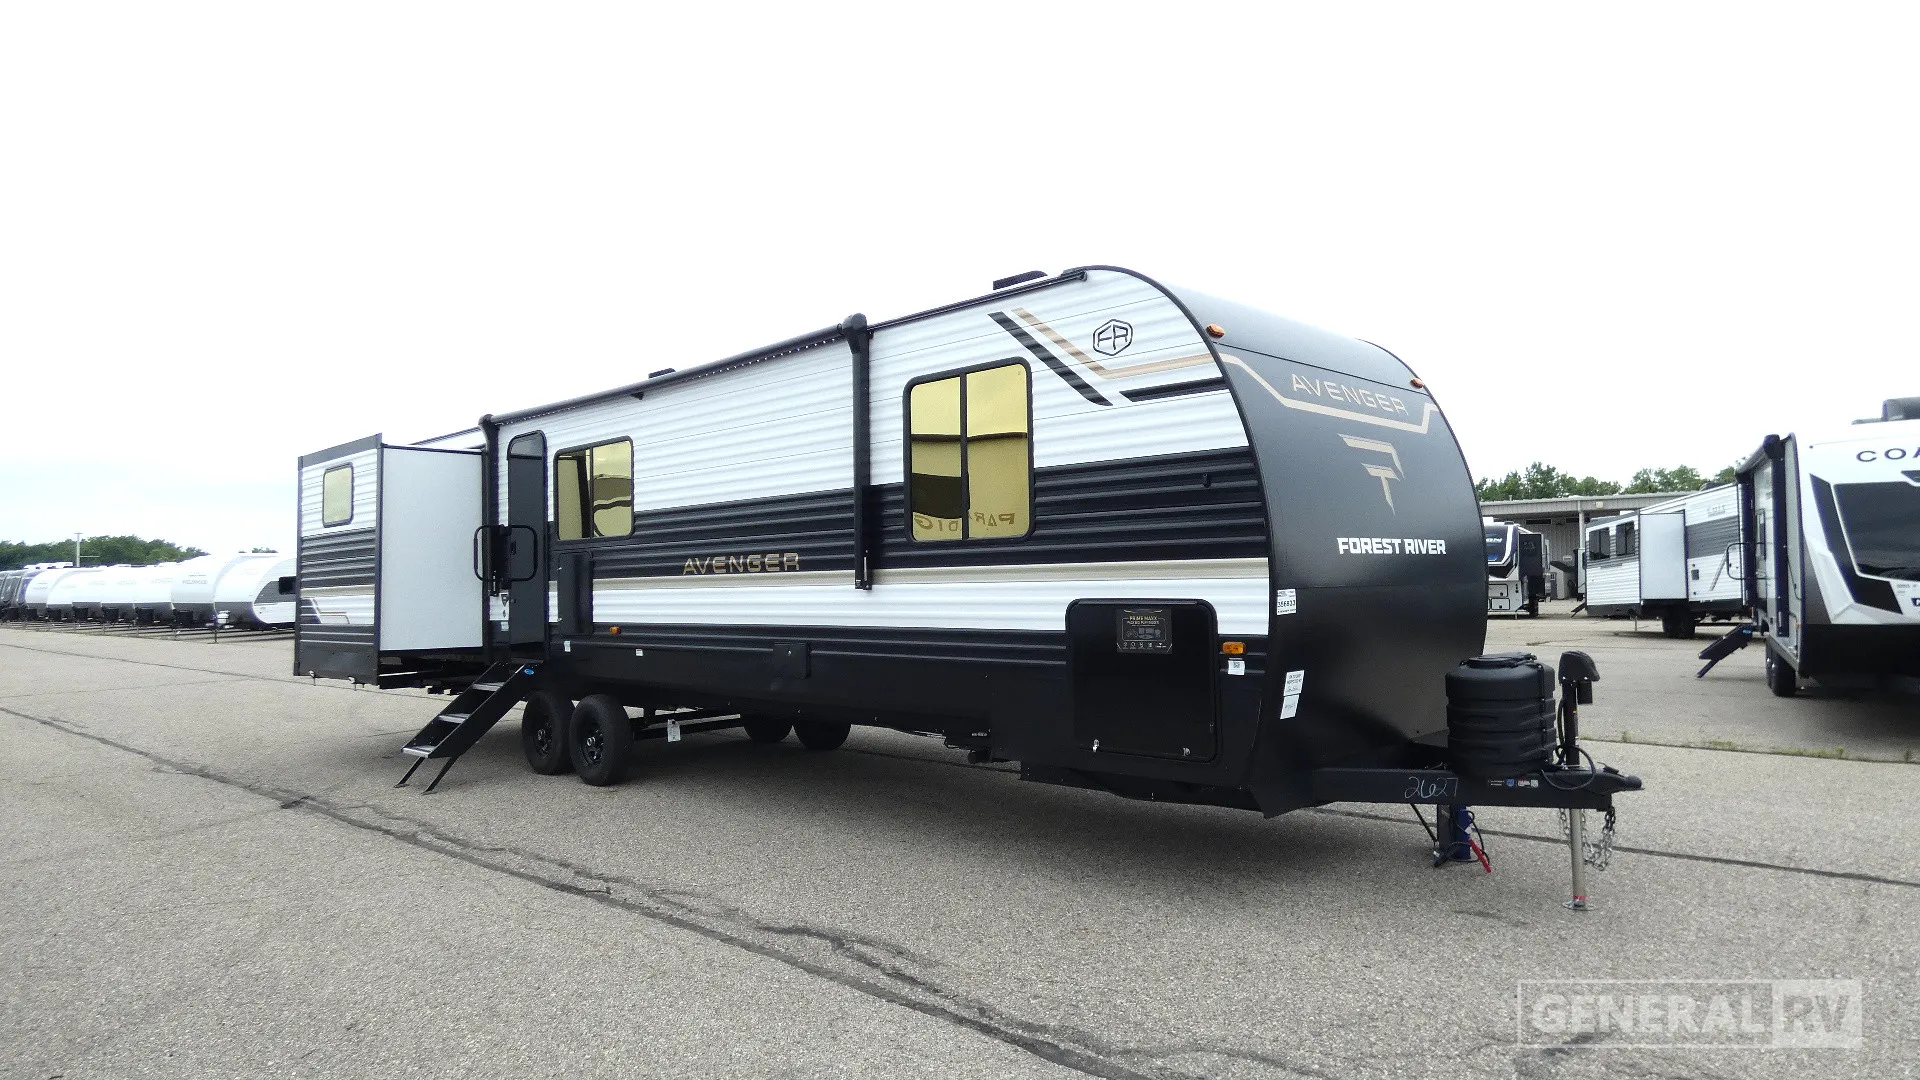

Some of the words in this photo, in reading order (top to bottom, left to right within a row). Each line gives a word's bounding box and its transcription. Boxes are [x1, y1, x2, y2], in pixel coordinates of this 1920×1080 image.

[1291, 373, 1409, 416] AVENGER
[1336, 537, 1402, 555] FOREST
[1403, 538, 1447, 555] RIVER
[683, 552, 800, 576] AVENGER
